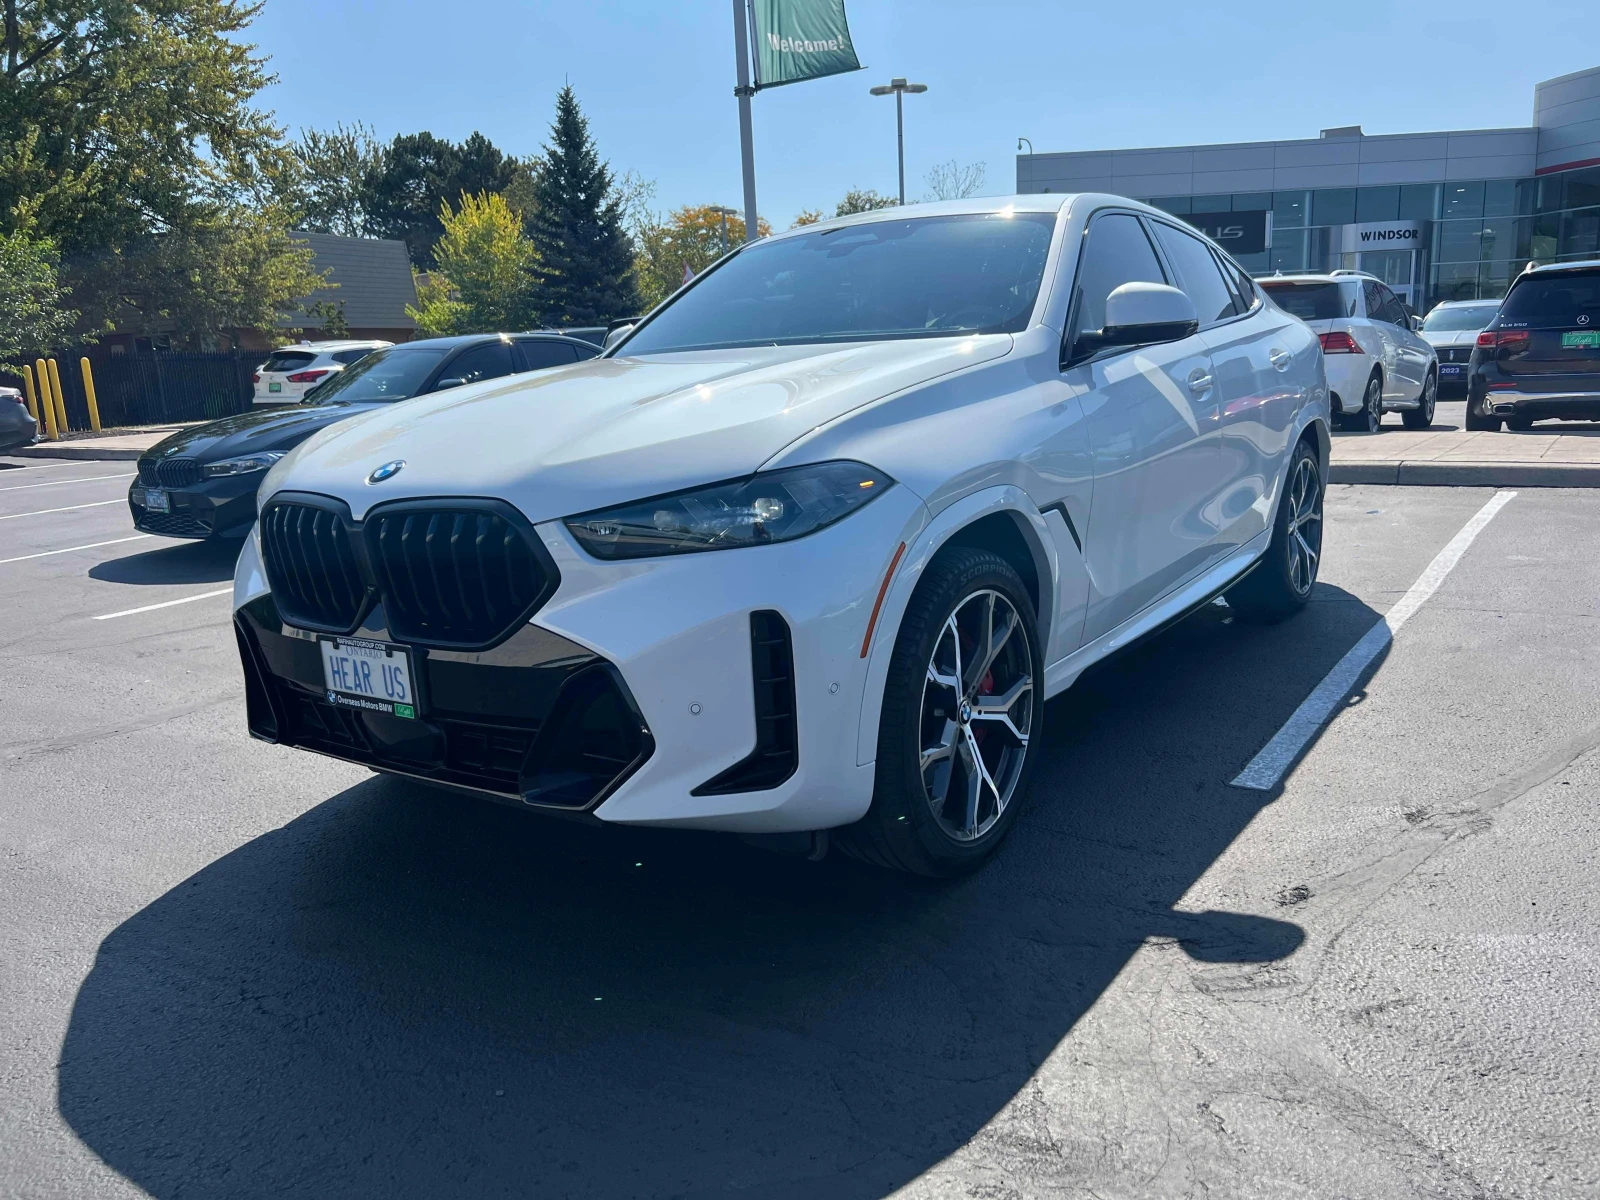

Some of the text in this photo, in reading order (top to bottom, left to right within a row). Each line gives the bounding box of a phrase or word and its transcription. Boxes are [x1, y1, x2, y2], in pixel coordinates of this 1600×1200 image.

[767, 33, 845, 53] Welcome!
[1360, 229, 1419, 242] WINDSOR
[960, 564, 1014, 586] SCORPION
[346, 646, 383, 659] ONTARIO
[329, 655, 406, 701] HEAR US
[337, 695, 393, 713] Overseas Motors BMW
